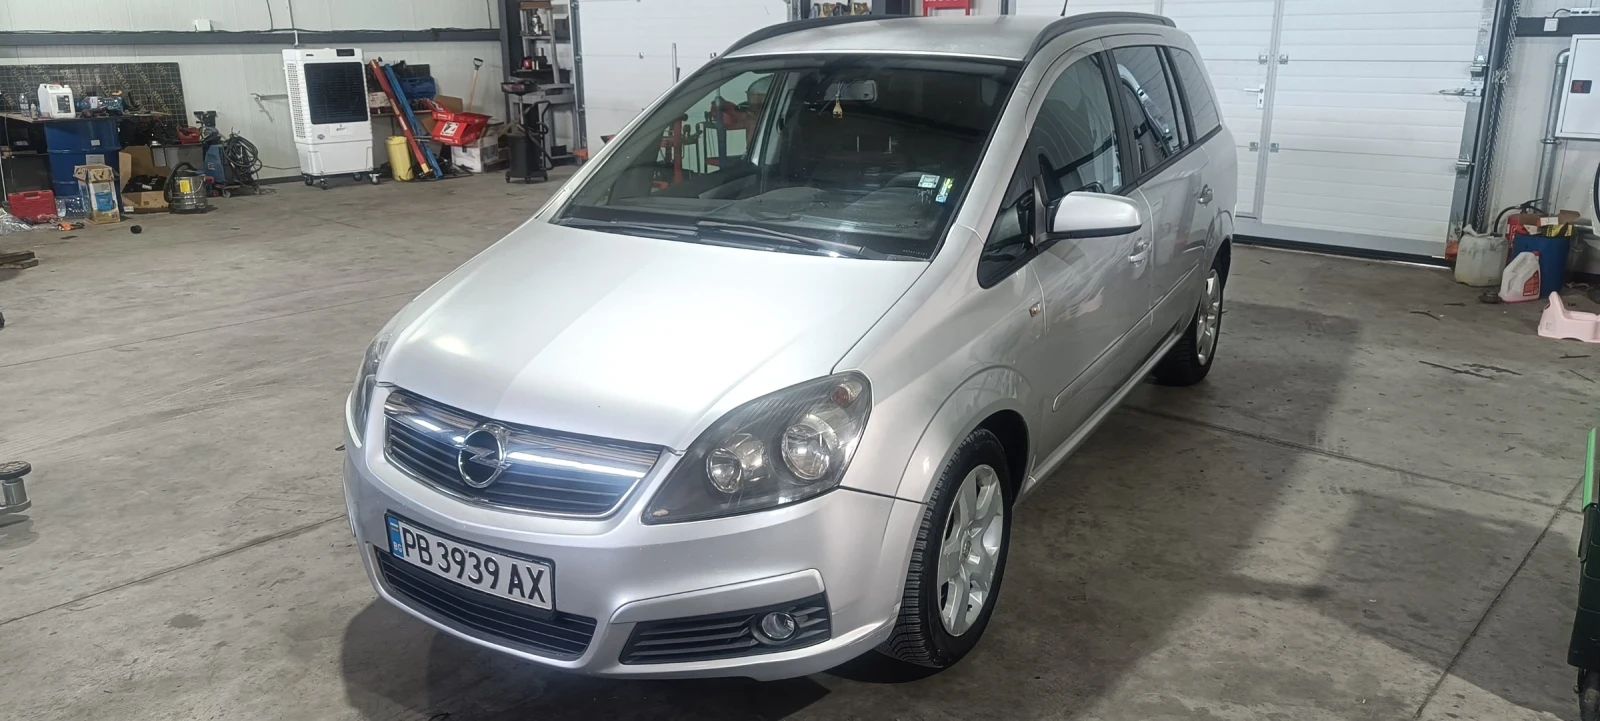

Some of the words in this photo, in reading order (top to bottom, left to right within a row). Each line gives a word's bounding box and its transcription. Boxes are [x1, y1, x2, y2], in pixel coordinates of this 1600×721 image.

[393, 541, 403, 552] BG
[402, 526, 432, 566] PB
[436, 542, 500, 590] 3939
[507, 563, 546, 603] AX
